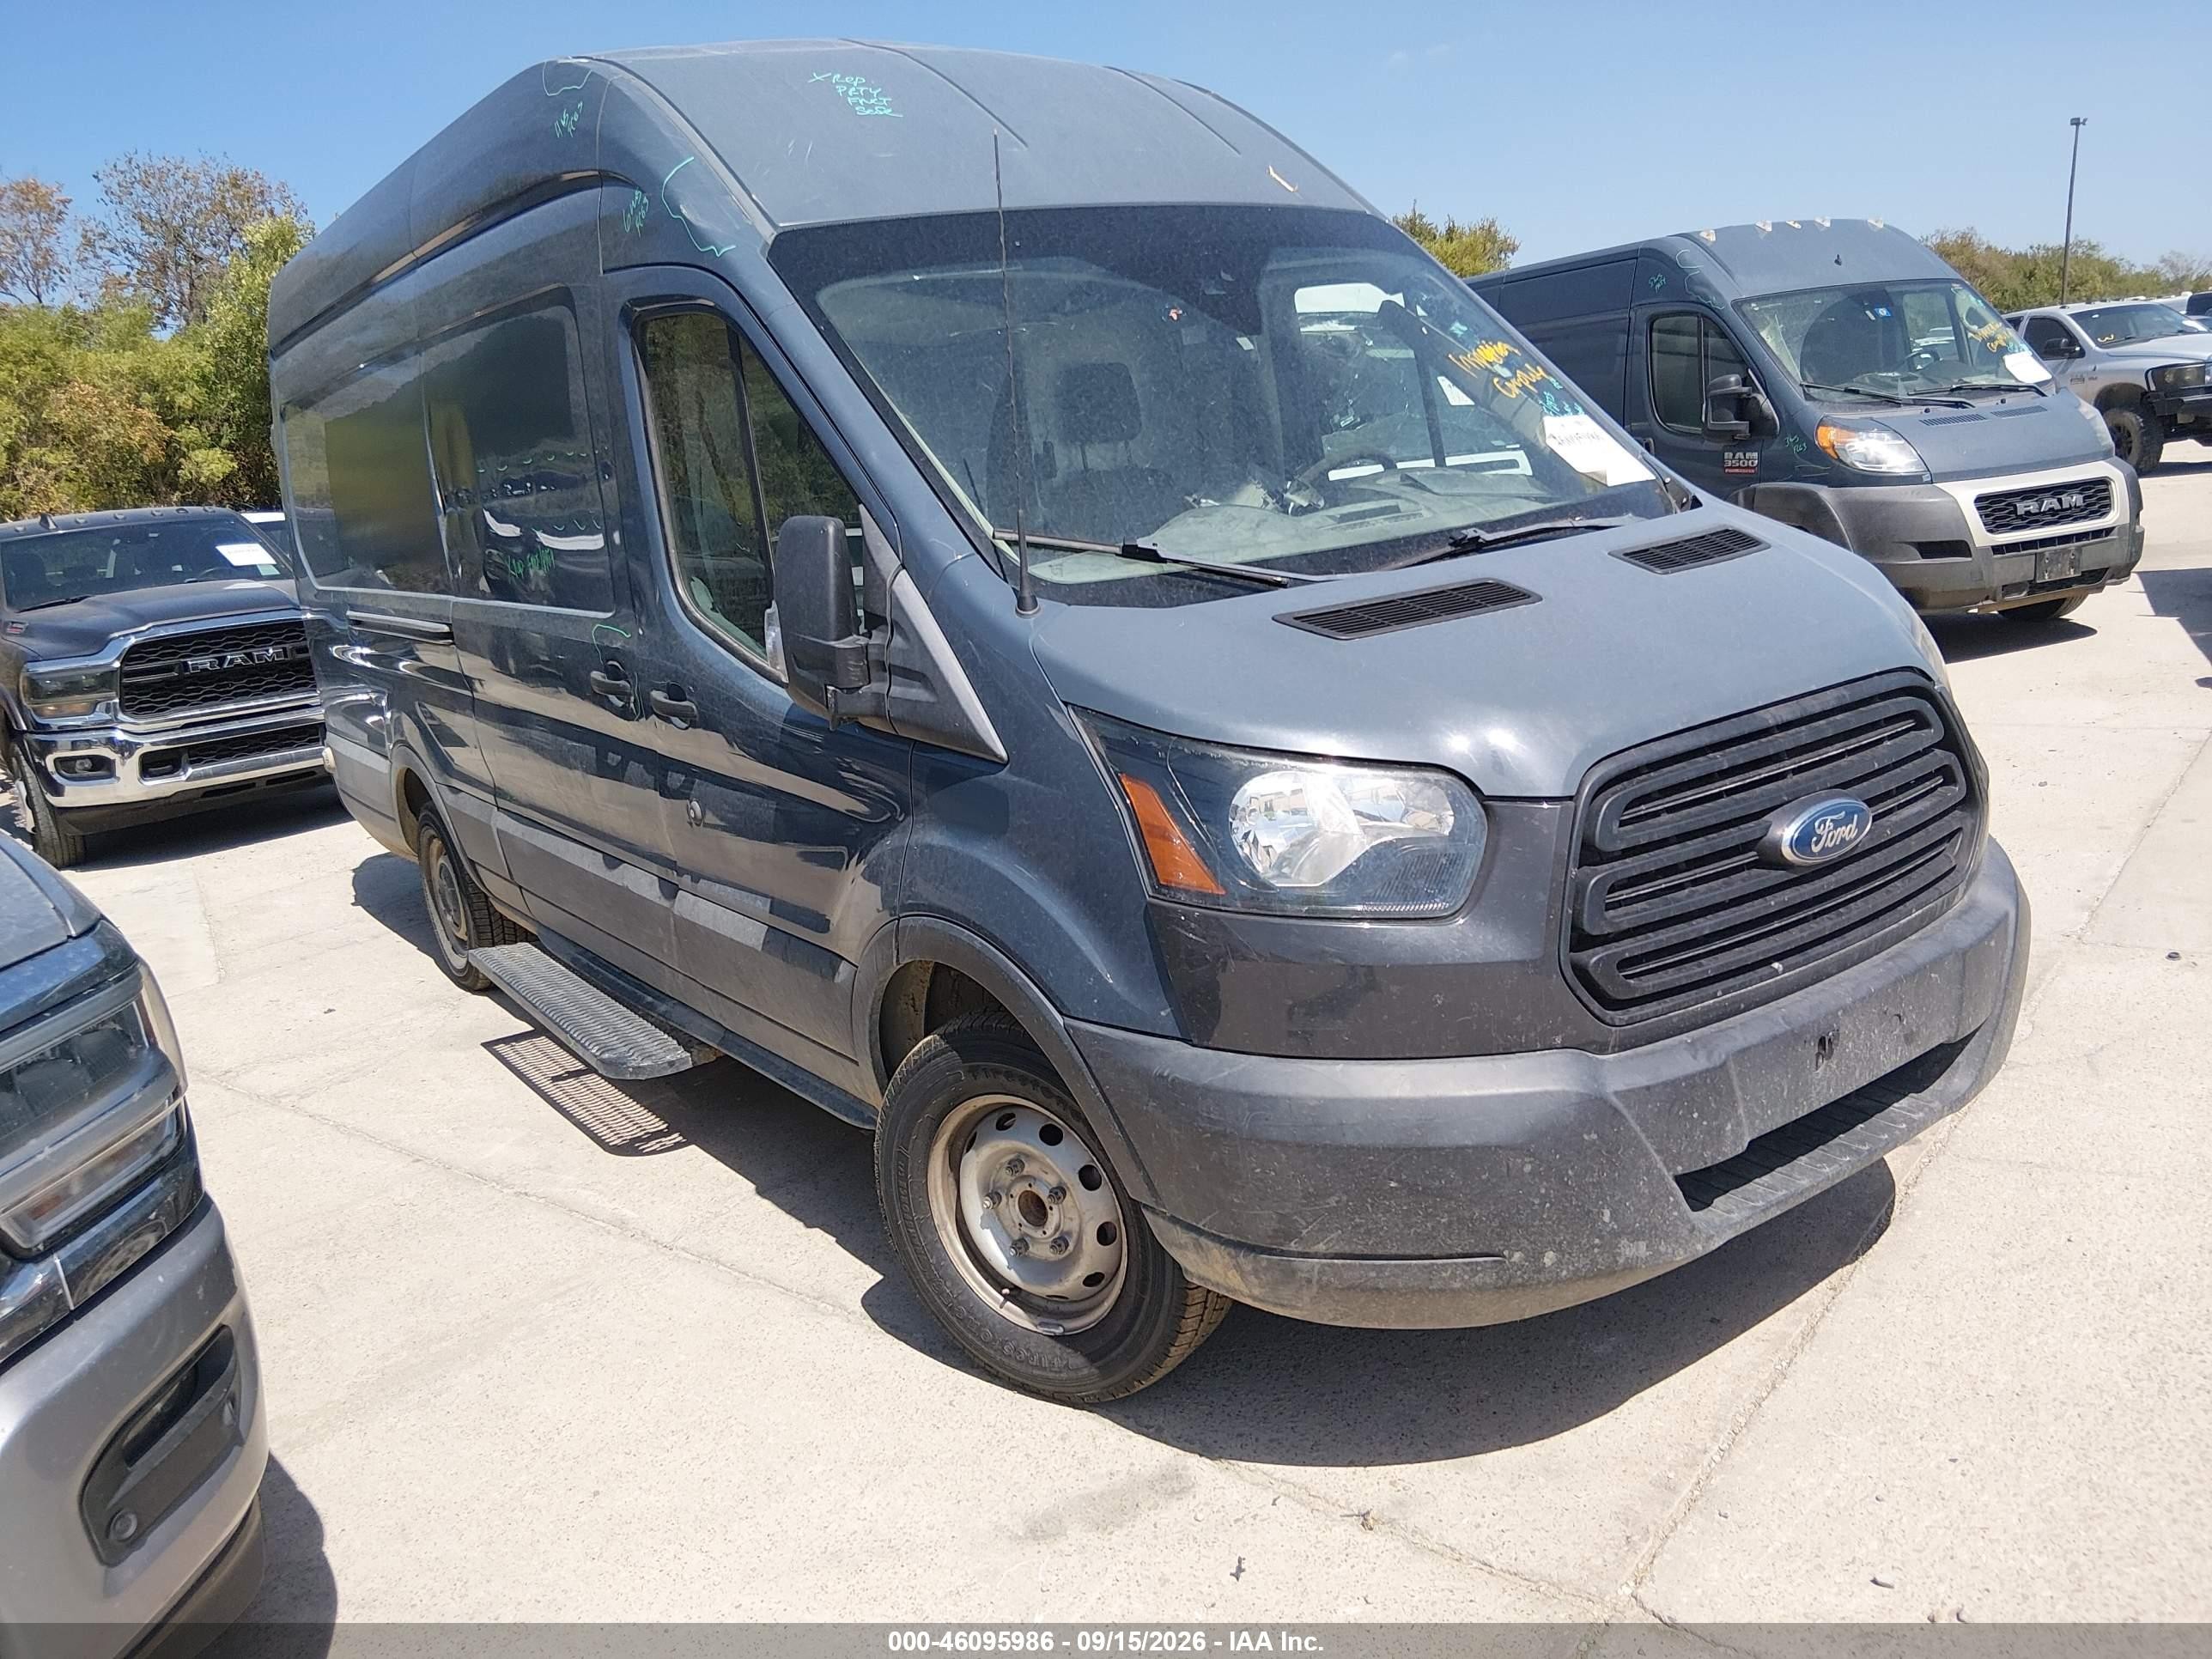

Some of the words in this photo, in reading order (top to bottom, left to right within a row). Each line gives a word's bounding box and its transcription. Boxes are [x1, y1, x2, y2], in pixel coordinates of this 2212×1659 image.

[2015, 494, 2084, 515] RAM
[186, 646, 287, 673] RAM
[1811, 811, 1859, 853] Ford
